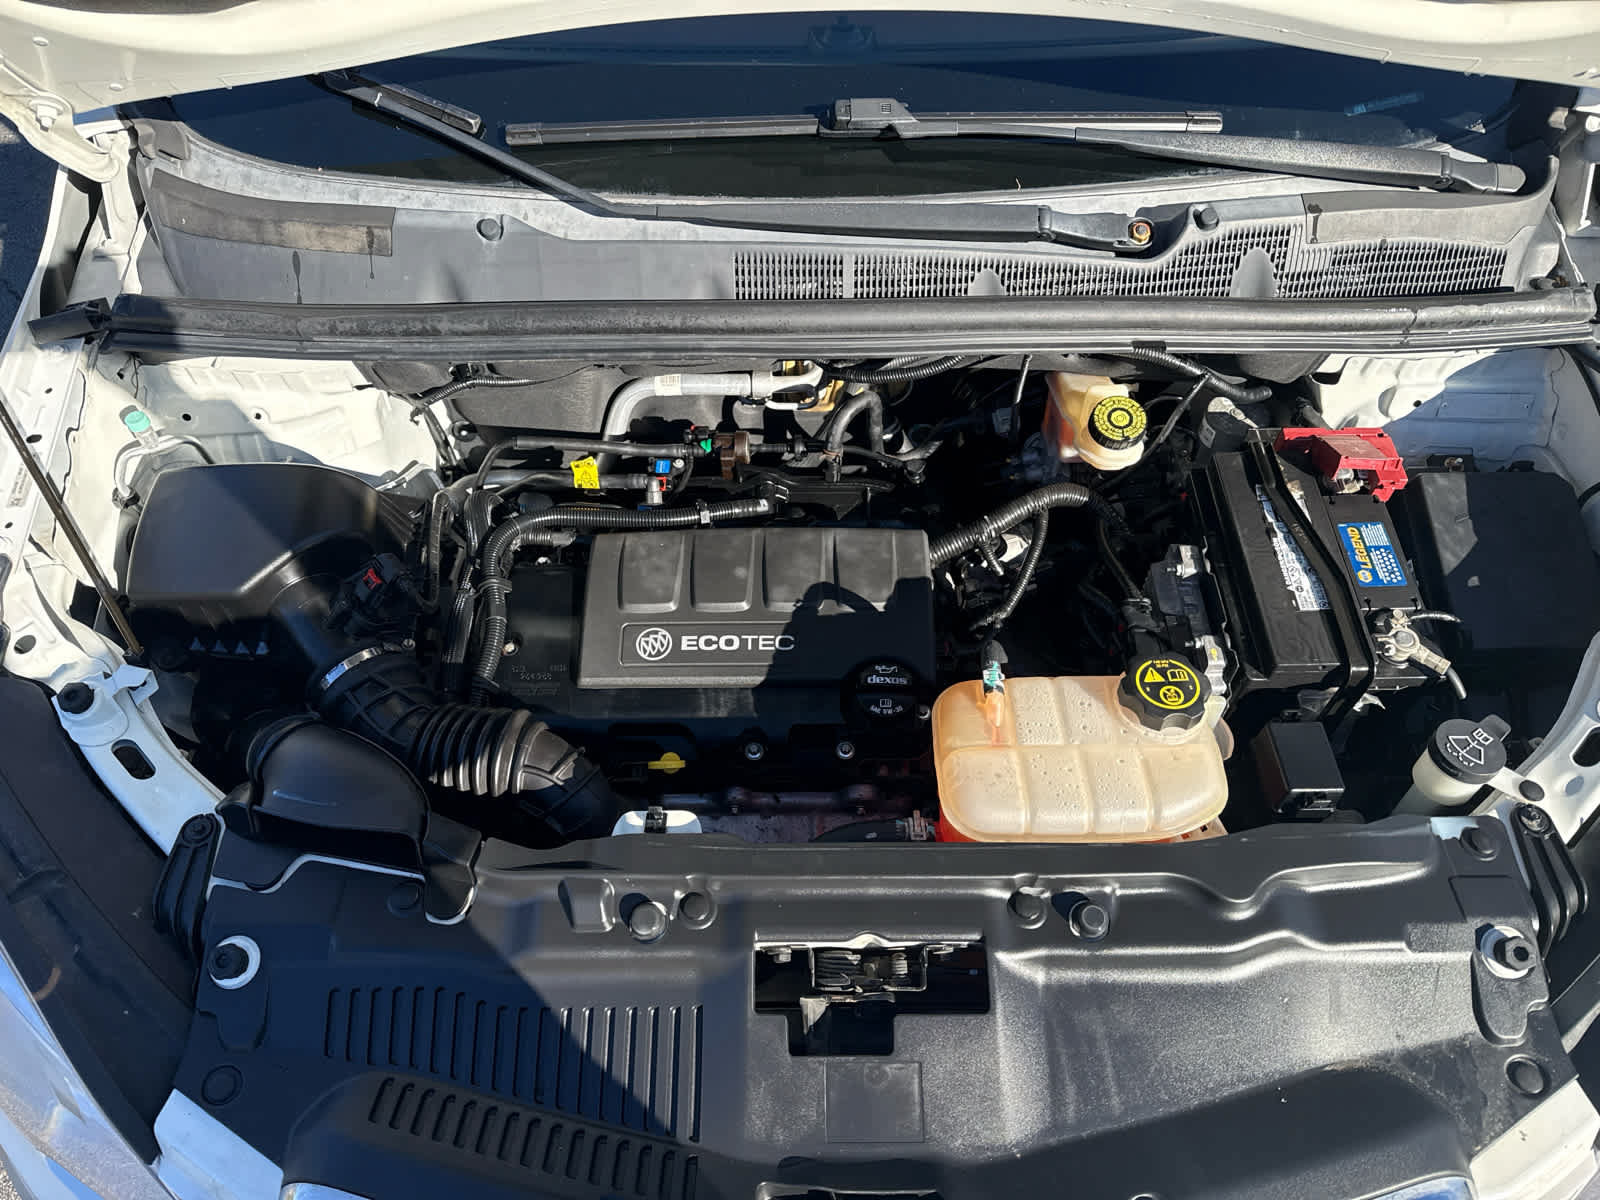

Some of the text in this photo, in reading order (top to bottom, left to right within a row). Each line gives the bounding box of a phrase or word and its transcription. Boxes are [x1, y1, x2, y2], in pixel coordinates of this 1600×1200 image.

[1347, 526, 1373, 568] LEGEND
[681, 634, 795, 651] ECOTEC
[866, 674, 908, 685] dexos
